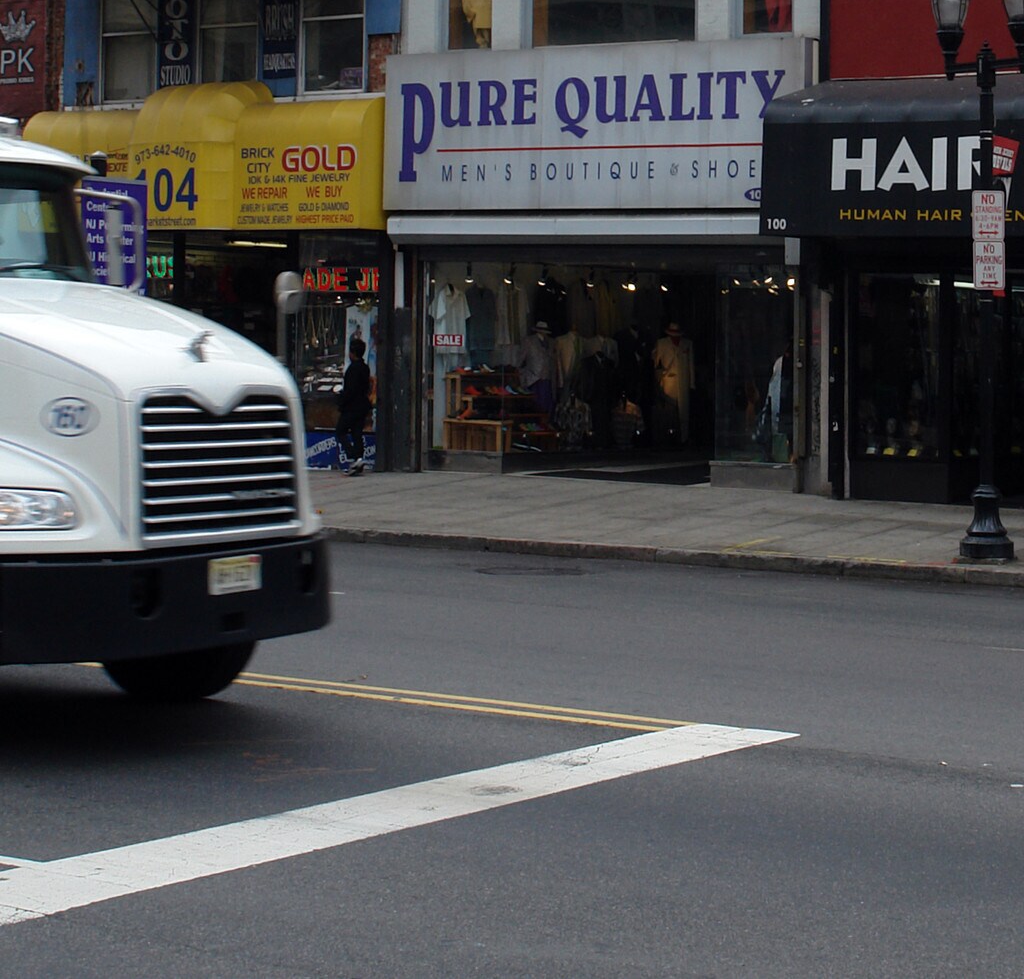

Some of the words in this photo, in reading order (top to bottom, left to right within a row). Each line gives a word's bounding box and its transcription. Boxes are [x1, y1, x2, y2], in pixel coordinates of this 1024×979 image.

[160, 64, 192, 86] STUDIO
[399, 78, 538, 183] PURE
[554, 69, 787, 139] QUALITY
[134, 143, 197, 166] 973-642-4010
[241, 147, 275, 159] BRICK
[281, 143, 358, 173] GOLD
[246, 162, 272, 174] CITY
[441, 163, 513, 183] MEN'S
[529, 160, 655, 181] BOUTIQUE
[288, 173, 309, 183] FINE
[310, 172, 351, 182] JEWELRY
[241, 187, 257, 200] WE
[257, 187, 288, 200] REPAIR
[305, 186, 321, 198] WE
[324, 185, 343, 198] BUY
[980, 193, 996, 205] NO
[86, 200, 112, 212] Cent
[298, 202, 315, 212] GOLD
[321, 201, 350, 211] DIAMOND
[974, 205, 1003, 214] STANDING
[295, 214, 320, 224] HIGHEST
[321, 214, 340, 224] PRICE
[340, 213, 355, 224] PAID
[839, 208, 907, 222] HUMAN
[915, 208, 963, 222] HAIR
[85, 218, 96, 230] NJ
[765, 218, 787, 230] 100
[86, 232, 104, 244] Arts
[982, 244, 995, 254] NO
[975, 255, 1003, 265] PARKING
[982, 272, 997, 280] TIME
[435, 334, 463, 347] SALE
